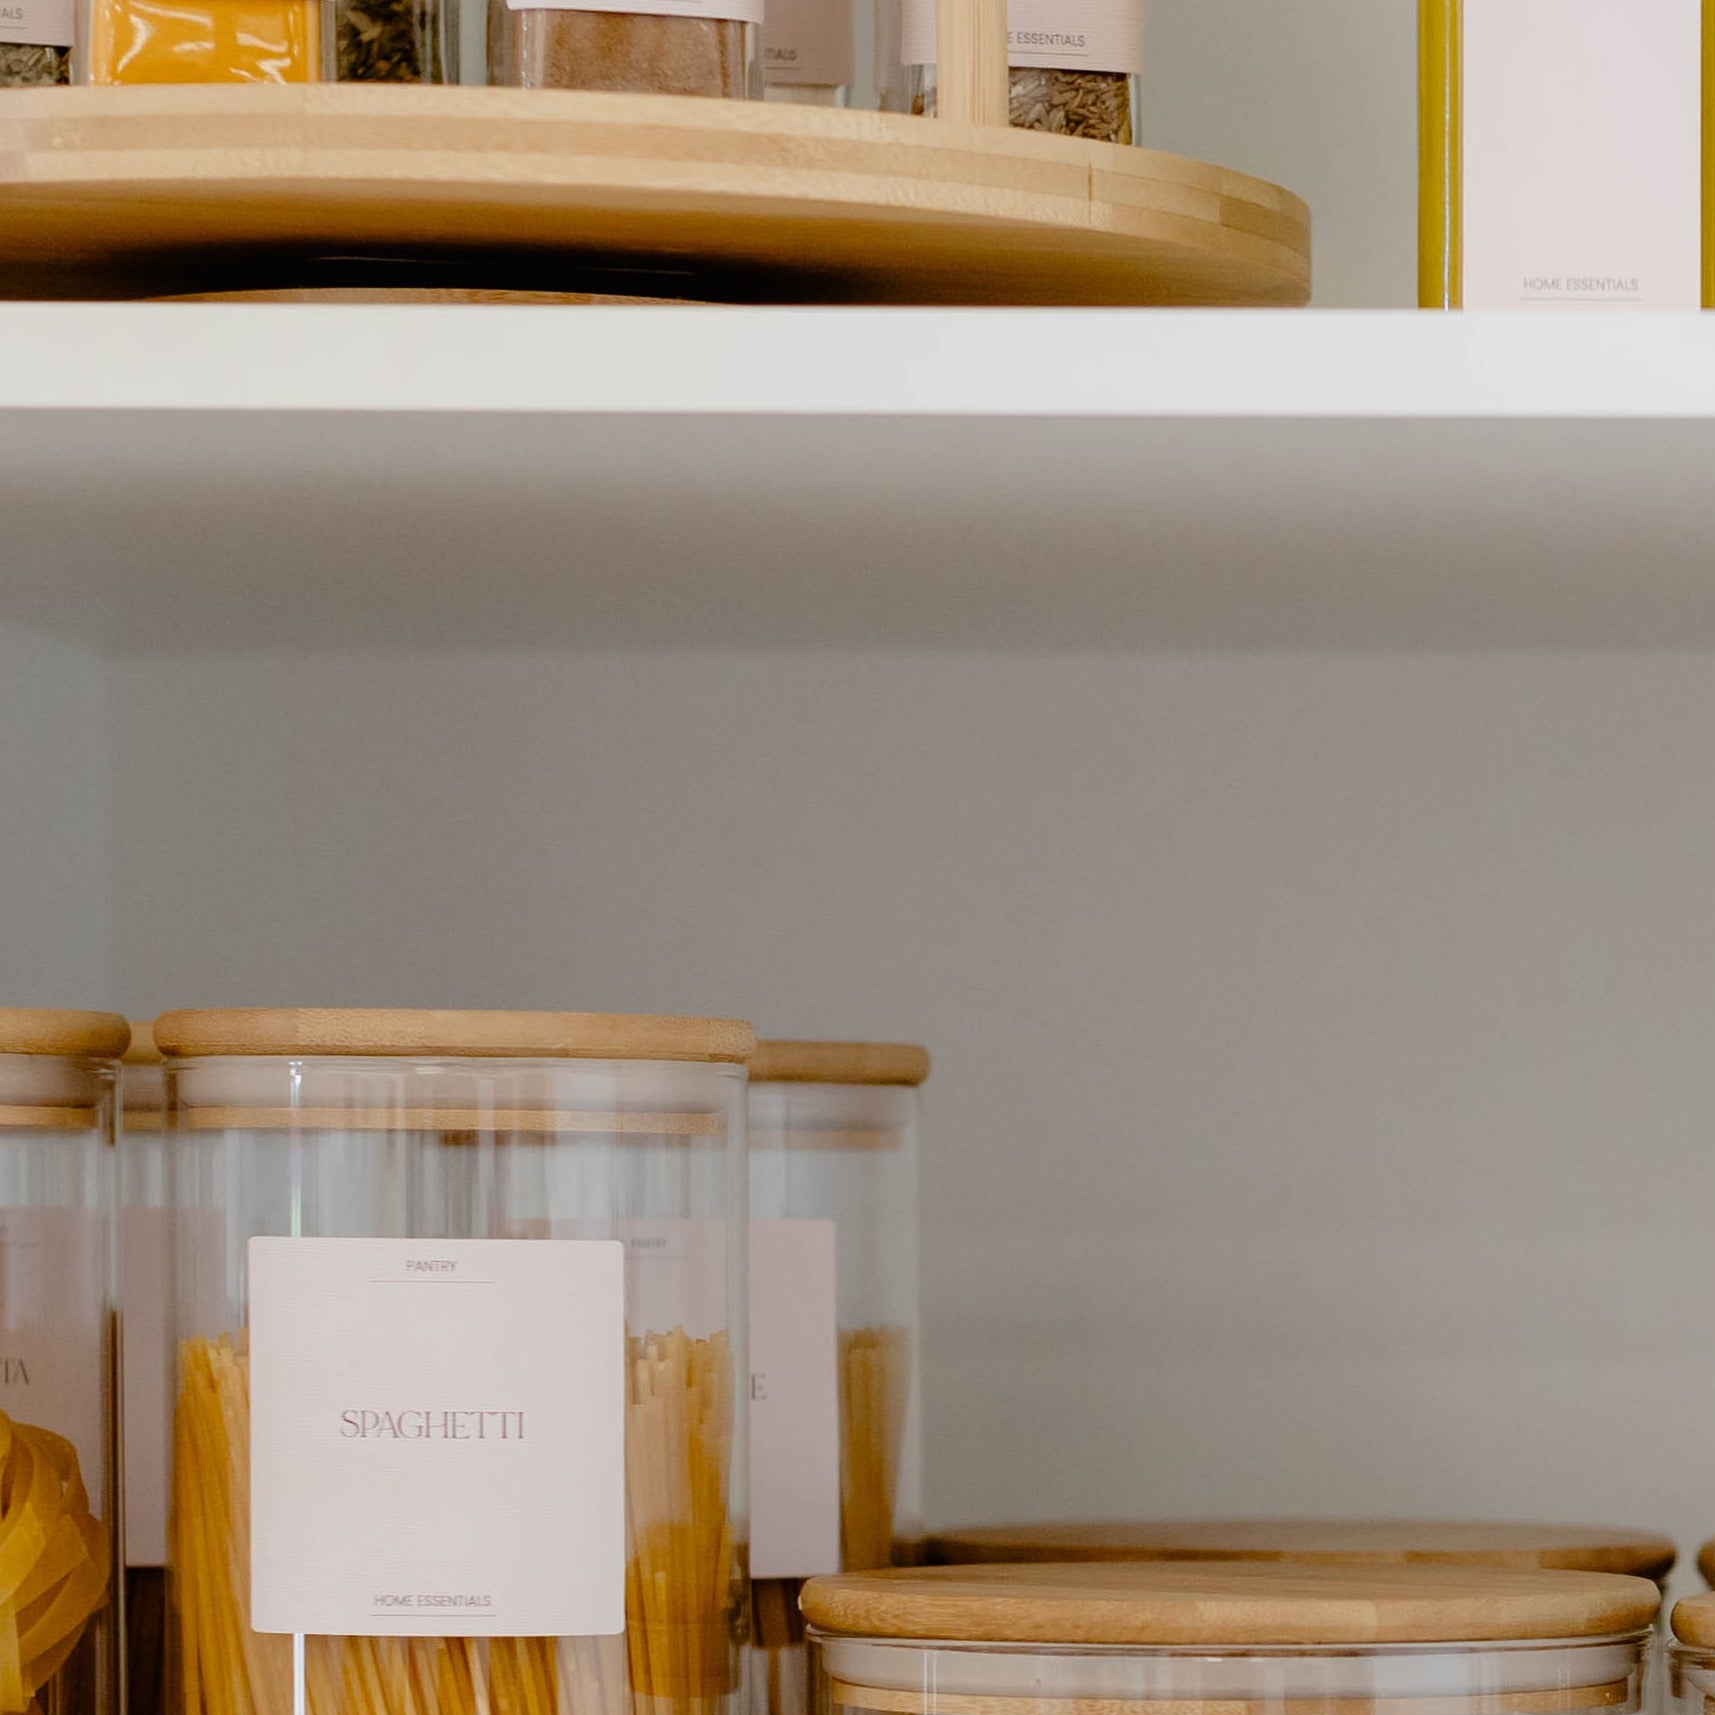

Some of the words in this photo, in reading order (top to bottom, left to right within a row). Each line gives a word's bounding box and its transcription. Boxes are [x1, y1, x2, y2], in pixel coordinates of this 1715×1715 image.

[1016, 31, 1086, 48] ESSENTIALS
[1523, 277, 1562, 291] HOME
[1566, 278, 1639, 292] ESSENTIALS
[405, 1259, 457, 1273] PANTRY
[340, 1409, 525, 1440] SPAGHETTI
[374, 1594, 414, 1607] HOME
[417, 1594, 492, 1607] ESSENTIALS
